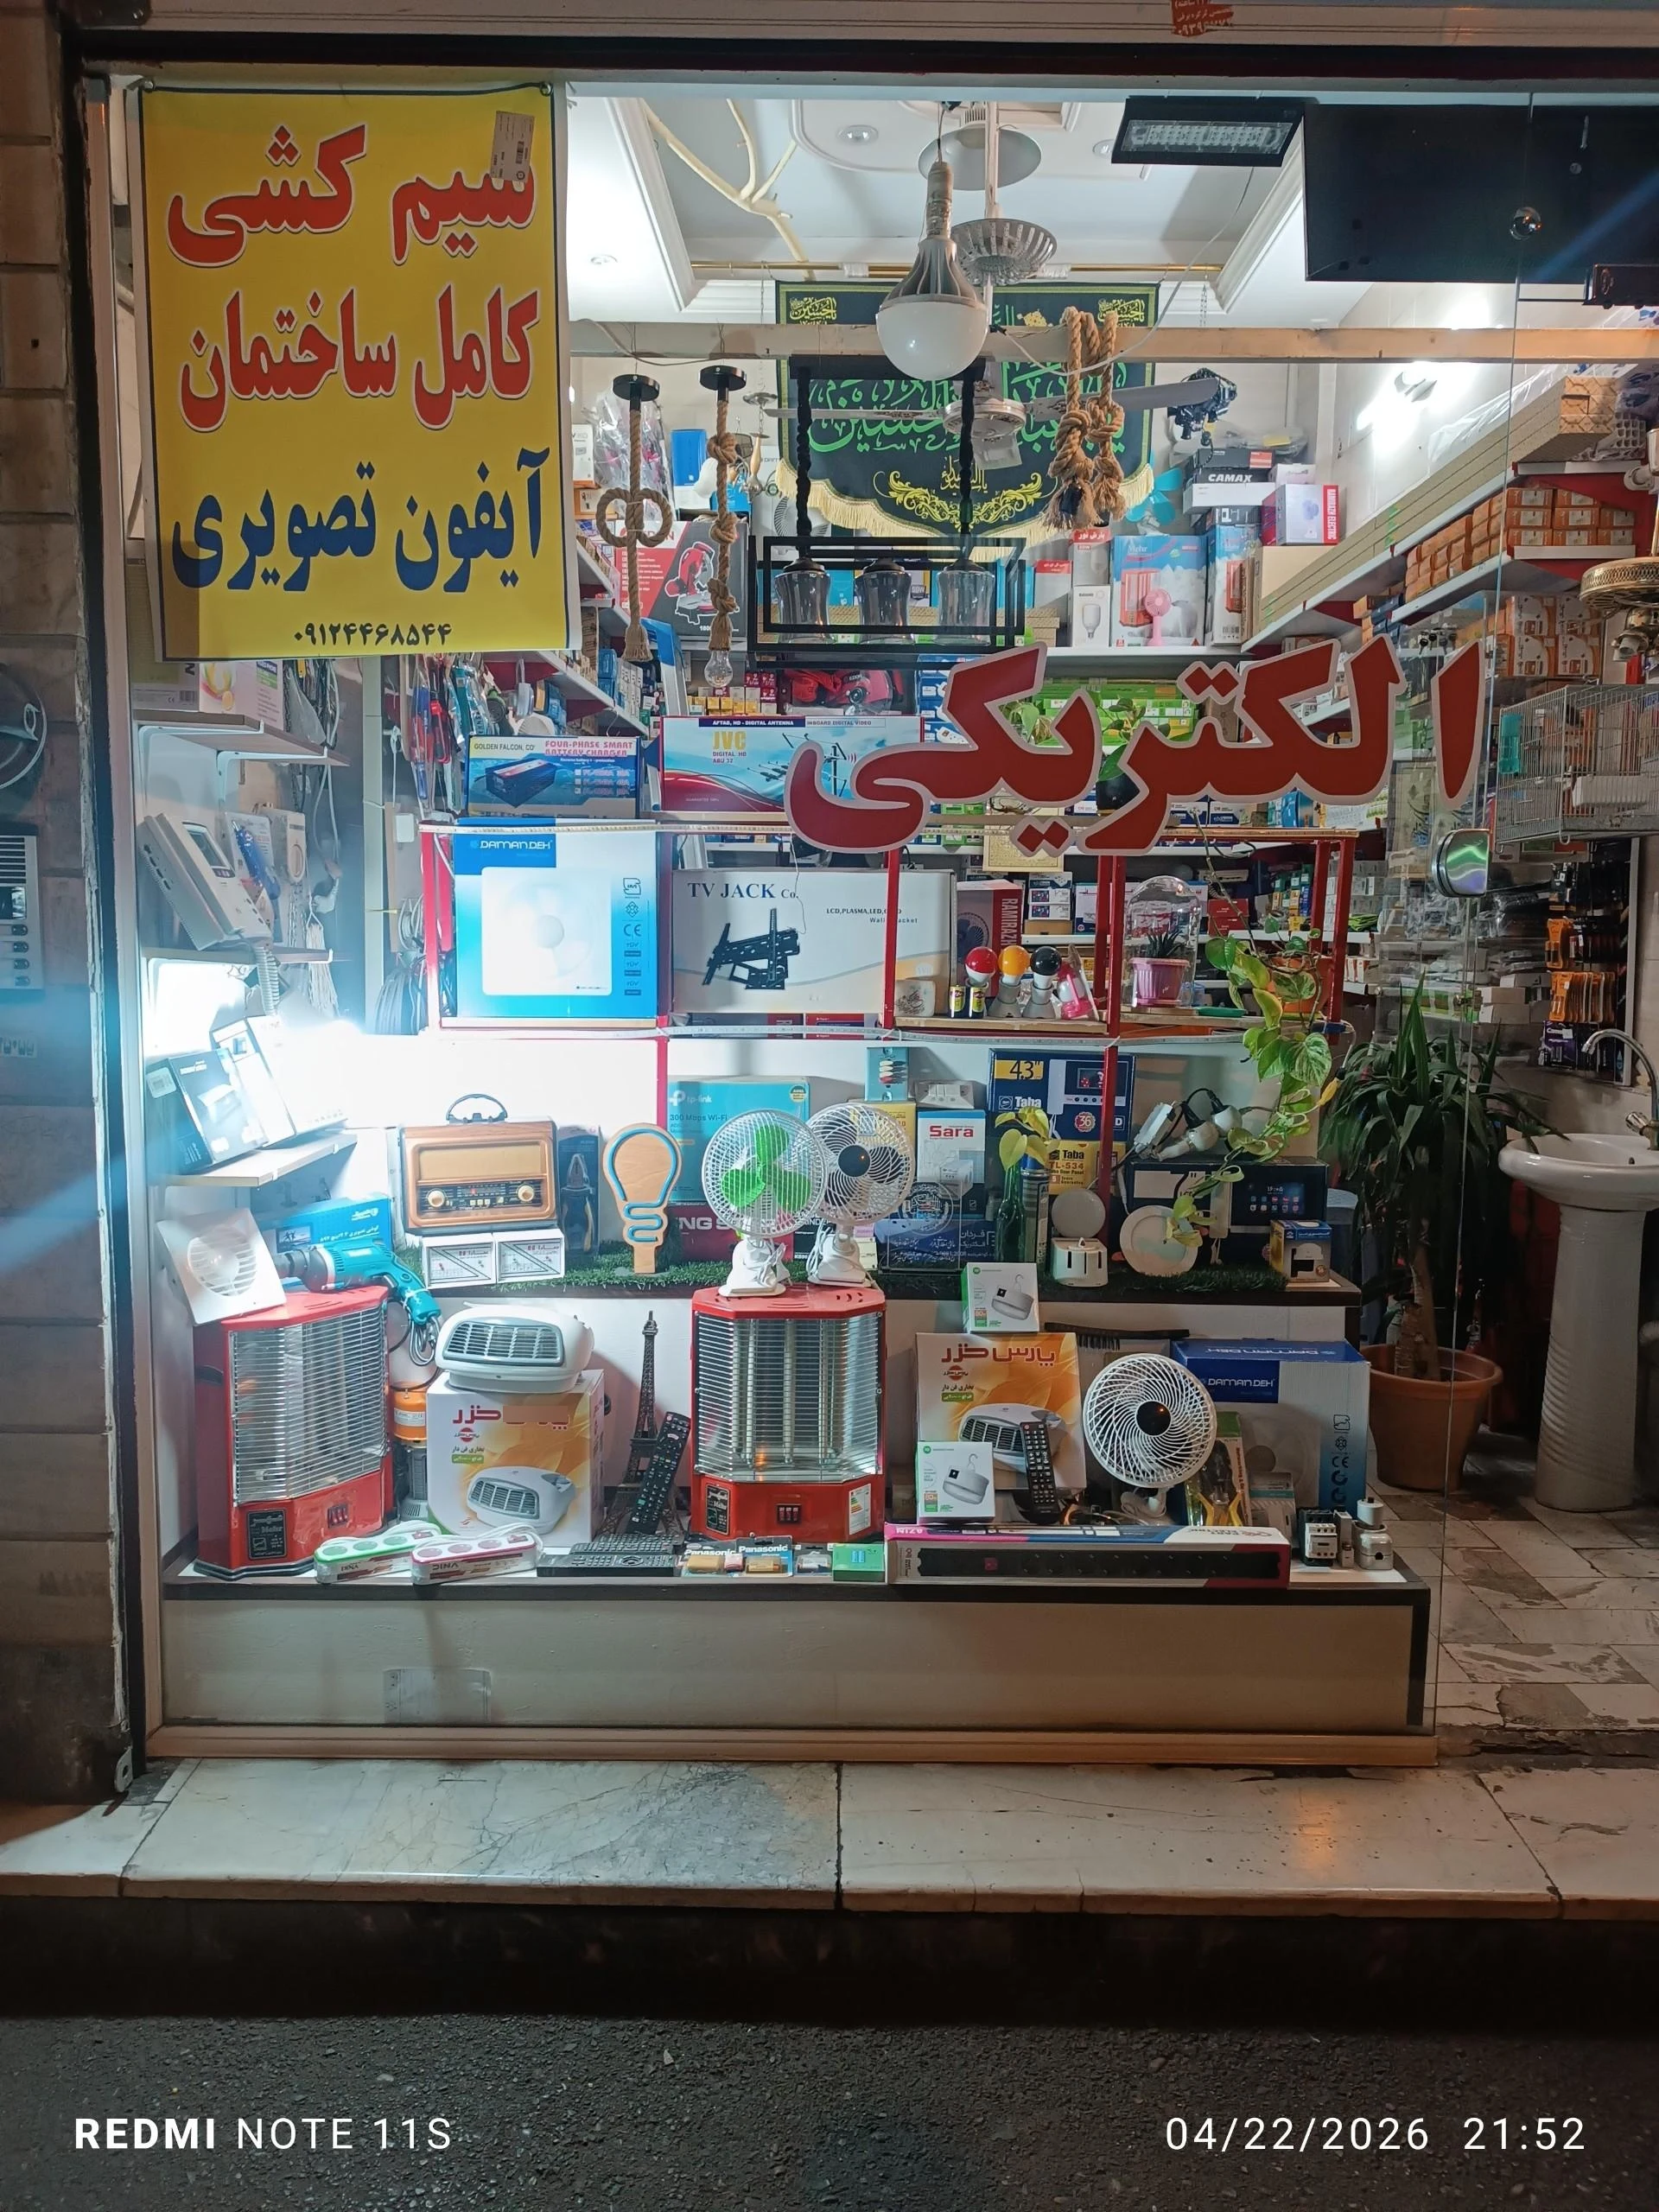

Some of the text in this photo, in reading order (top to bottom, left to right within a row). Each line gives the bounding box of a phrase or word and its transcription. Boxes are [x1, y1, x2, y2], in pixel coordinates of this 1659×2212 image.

[168, 124, 366, 264] کشی
[392, 166, 537, 264] سیم
[181, 285, 538, 429] کامل ساختمان
[1208, 474, 1252, 483] CAMAX
[174, 446, 550, 593] آیفون تصویری
[294, 622, 452, 645] ۰۹۱۲۴۴۶۸۵۴۴
[603, 741, 633, 749] SMART
[712, 730, 747, 750] JVC
[788, 635, 1484, 854] الکتریکی
[499, 743, 524, 752] FALCON,
[480, 839, 550, 850] DAMANDEH
[687, 882, 799, 899] TV JACK Co.
[1001, 898, 1020, 947] RAMIRAZH
[623, 924, 641, 938] CE
[686, 1094, 713, 1104] tp-link
[1014, 1096, 1042, 1109] Taba
[1078, 1116, 1092, 1127] 36
[929, 1124, 974, 1138] Sara
[1063, 1149, 1084, 1160] Taba
[941, 1343, 1056, 1367] پارس خزر
[1207, 1377, 1274, 1388] DAMANDEH
[452, 1404, 502, 1425] خزر
[1332, 1456, 1350, 1468] CE
[683, 1548, 735, 1556] Panasonic
[738, 1544, 789, 1554] Panasonic
